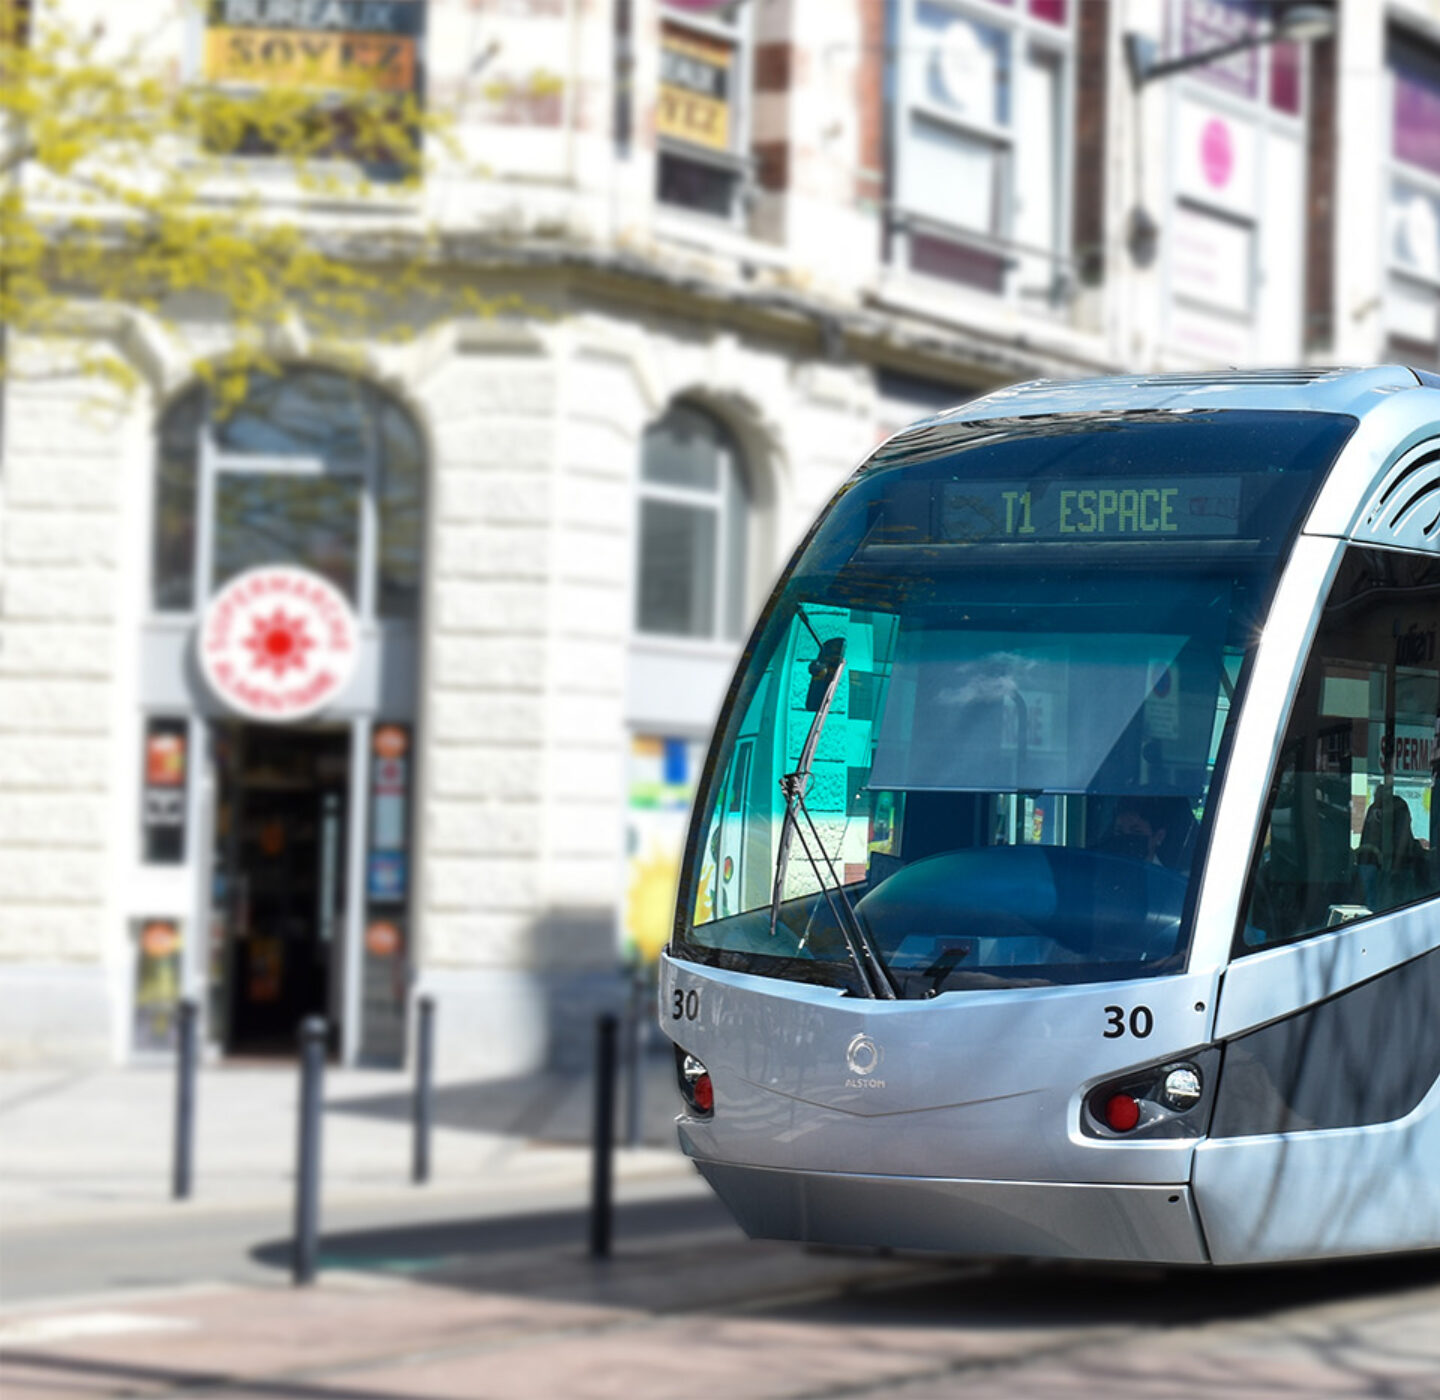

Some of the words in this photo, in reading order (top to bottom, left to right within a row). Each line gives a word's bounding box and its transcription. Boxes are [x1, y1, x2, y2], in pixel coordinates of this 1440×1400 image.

[229, 36, 403, 70] SOYEZ
[1002, 491, 1035, 534] T1
[1059, 488, 1179, 533] ESPACE
[672, 988, 699, 1021] 30
[1103, 1005, 1154, 1039] 30
[844, 1078, 887, 1089] ALSTOM
